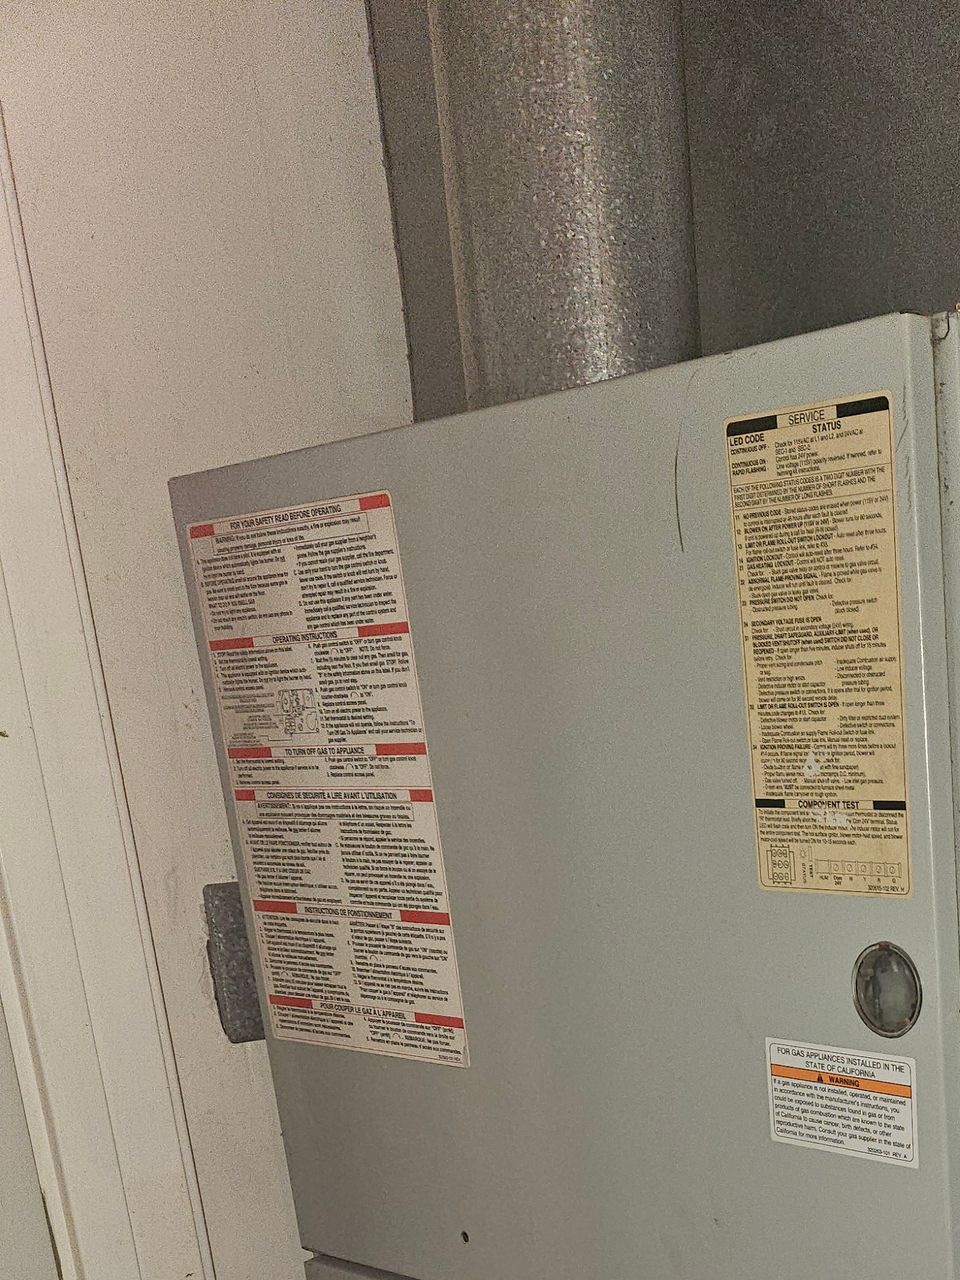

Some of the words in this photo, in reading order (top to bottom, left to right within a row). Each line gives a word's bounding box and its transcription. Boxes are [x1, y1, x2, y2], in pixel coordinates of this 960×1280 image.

[788, 410, 825, 425] SERVICE
[812, 420, 841, 433] STATUS
[729, 437, 743, 447] LED
[745, 433, 764, 444] CODE
[730, 446, 758, 455] CONTINUOUS
[732, 460, 759, 469] CONTINUOUS
[746, 466, 766, 474] FLASHING
[230, 521, 240, 530] FOR
[241, 519, 255, 528] YOUR
[255, 516, 274, 526] SAFETY
[290, 510, 310, 520] BEFORE
[311, 504, 342, 516] OPERATING
[272, 634, 300, 644] OPERATING
[301, 631, 338, 641] INSTRUCTIONS
[842, 801, 859, 809] TEST
[304, 907, 339, 915] INSTRUCTIONS
[777, 1047, 790, 1055] FOR
[791, 1049, 805, 1057] GAS
[806, 1052, 845, 1064] APPLIANCES
[846, 1057, 881, 1069] INSTALLED
[891, 1064, 904, 1073] THE
[805, 1061, 826, 1070] STATE
[837, 1066, 876, 1078] CALIFORNIA
[829, 1076, 859, 1087] WARNING
[780, 1088, 805, 1096] accordance
[825, 1096, 859, 1106] manufacturer's
[879, 1097, 906, 1106] maintained
[821, 1104, 846, 1112] substances
[781, 1111, 802, 1120] California
[810, 1110, 836, 1118] combustion
[776, 1126, 797, 1136] California
[776, 1120, 803, 1129] reproductive
[819, 1127, 836, 1135] Consult
[858, 1135, 877, 1143] supplier
